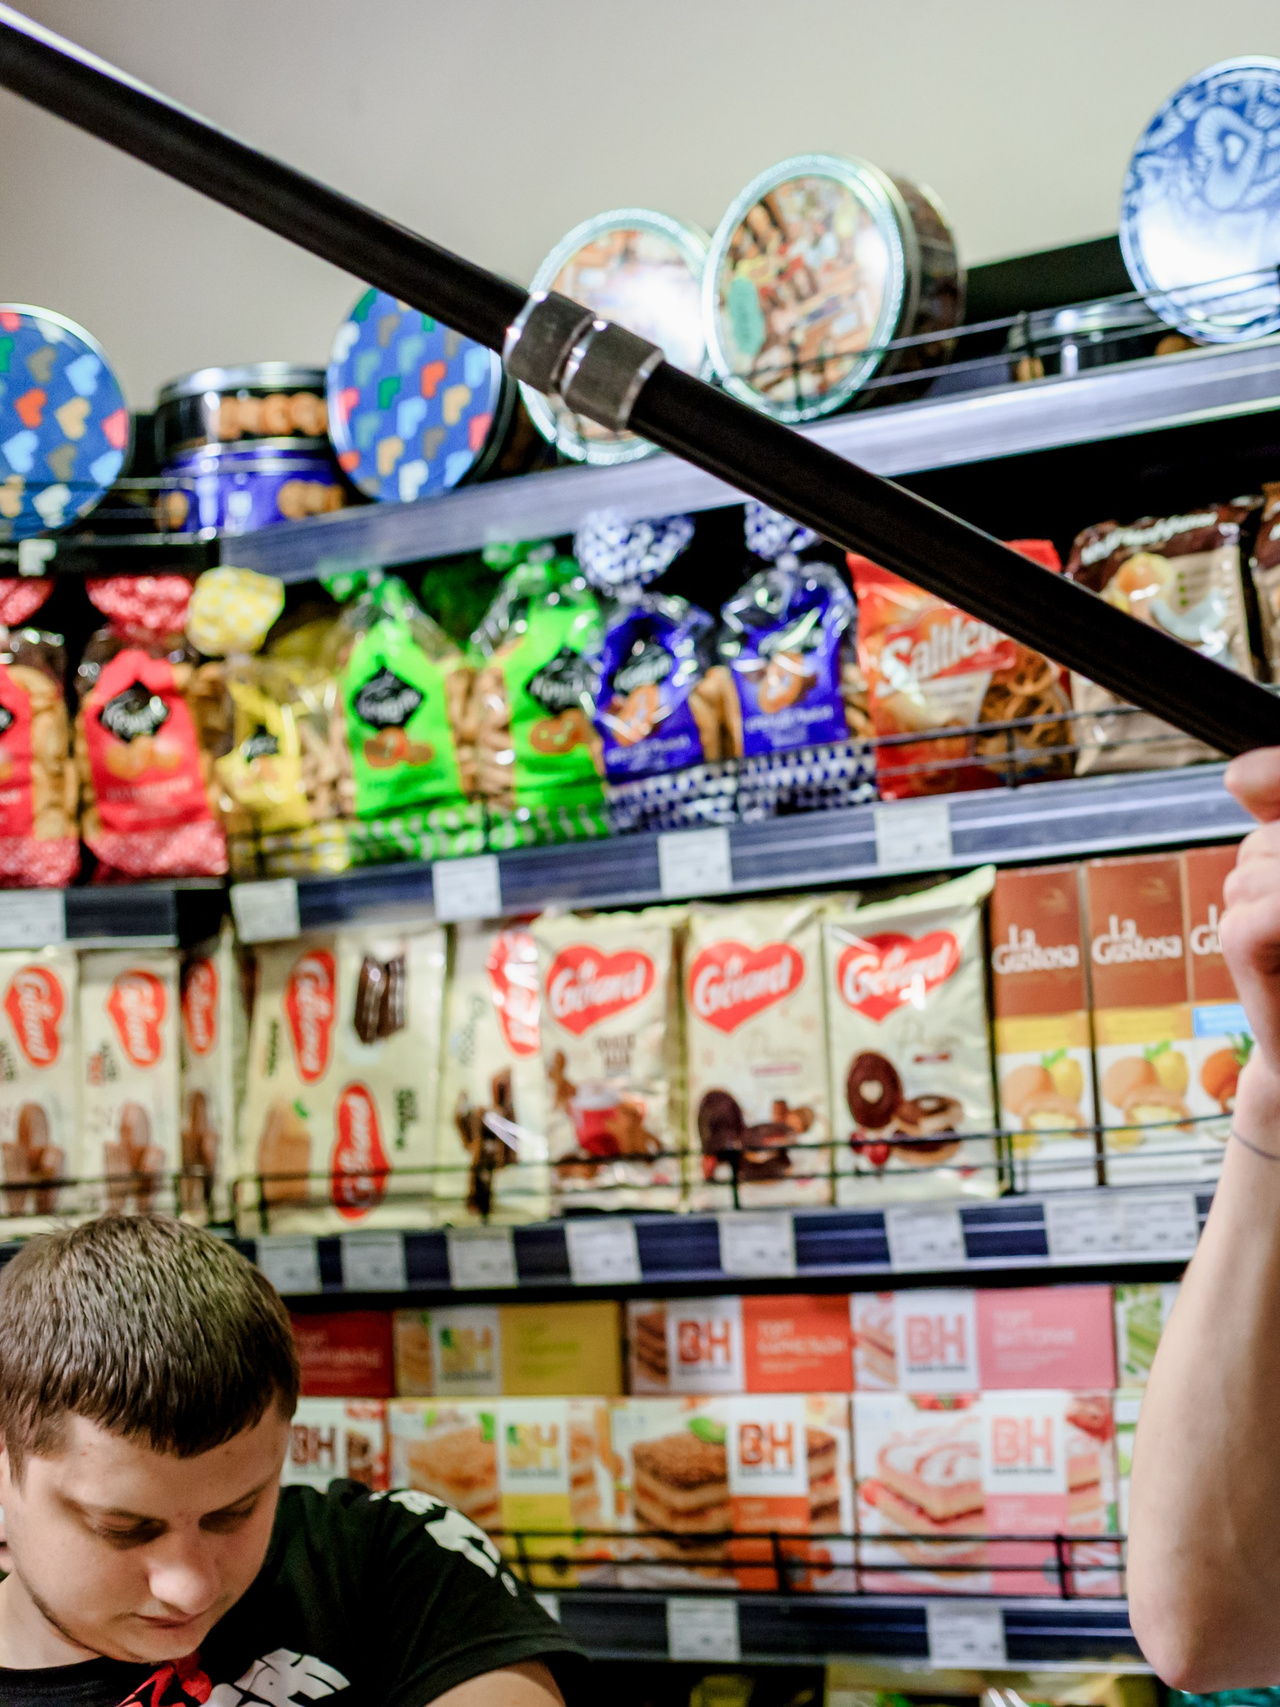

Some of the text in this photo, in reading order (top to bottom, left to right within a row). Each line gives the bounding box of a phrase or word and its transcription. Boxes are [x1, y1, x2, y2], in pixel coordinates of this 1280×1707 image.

[1091, 934, 1183, 965] Gustosa
[678, 1317, 732, 1364] BH
[905, 1314, 967, 1364] BH
[738, 1421, 794, 1467] BH
[991, 1415, 1054, 1467] BH
